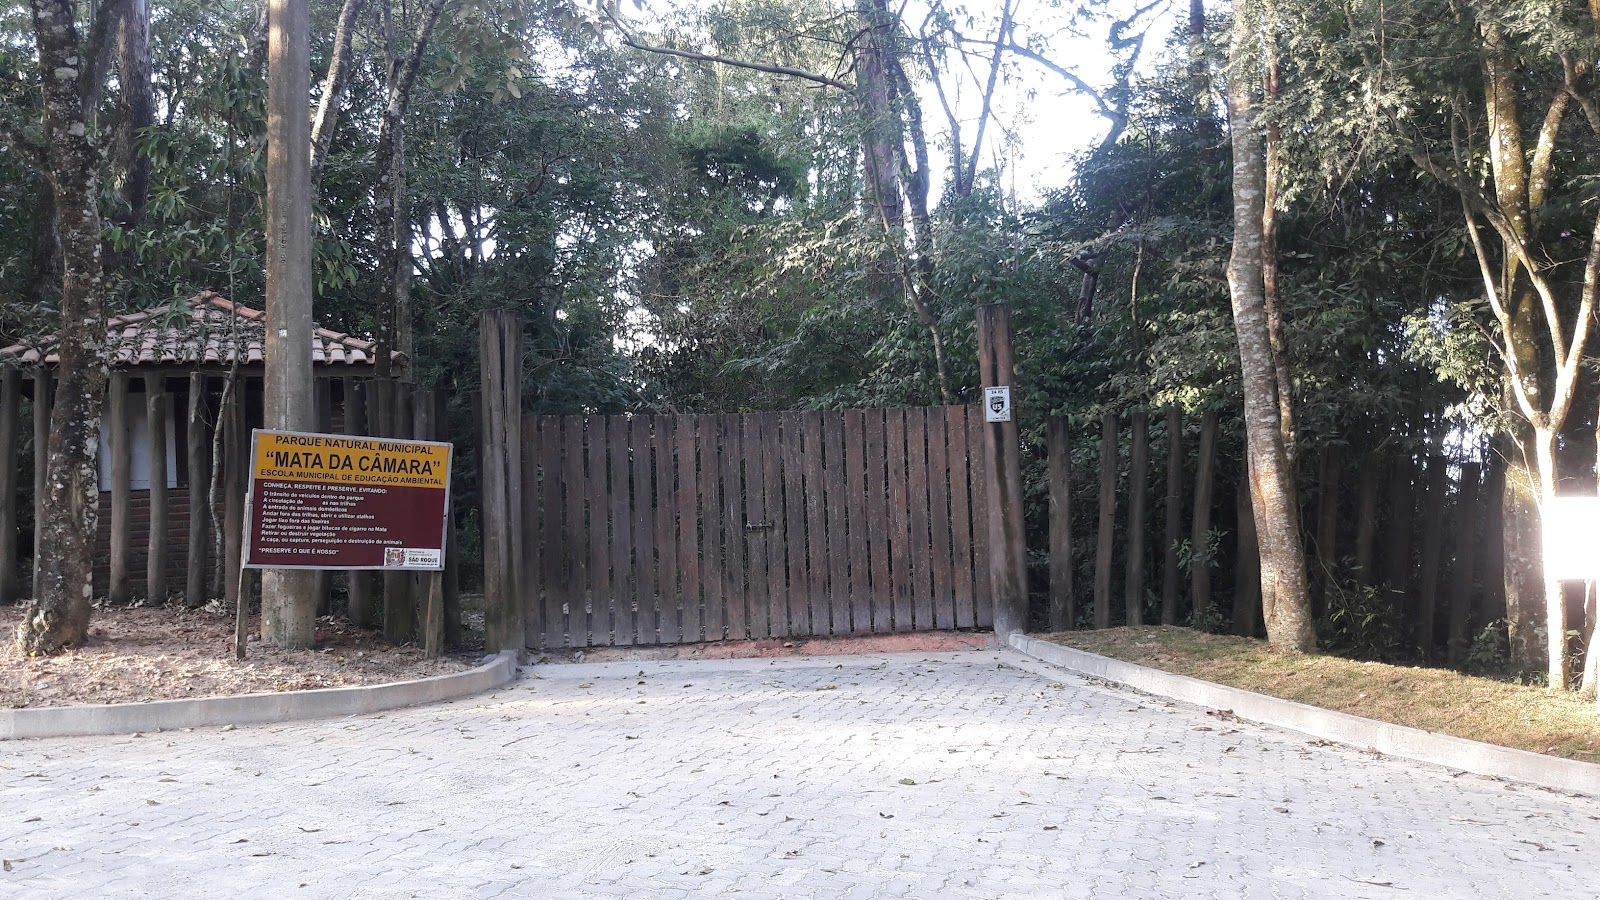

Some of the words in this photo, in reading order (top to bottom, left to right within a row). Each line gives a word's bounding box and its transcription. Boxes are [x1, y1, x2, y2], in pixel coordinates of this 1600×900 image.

[276, 436, 321, 447] PARQUE
[325, 439, 375, 451] NATURAL
[378, 442, 433, 454] MUNICIPAL
[266, 451, 324, 469] “MATA
[329, 454, 353, 470] DA
[359, 453, 440, 475] CÂMARA”
[261, 469, 294, 477] ESCOLA
[297, 471, 339, 480] MUNICIPAL
[355, 474, 398, 484] EDUCAÇÃO
[400, 476, 443, 485] AMBIENTAL
